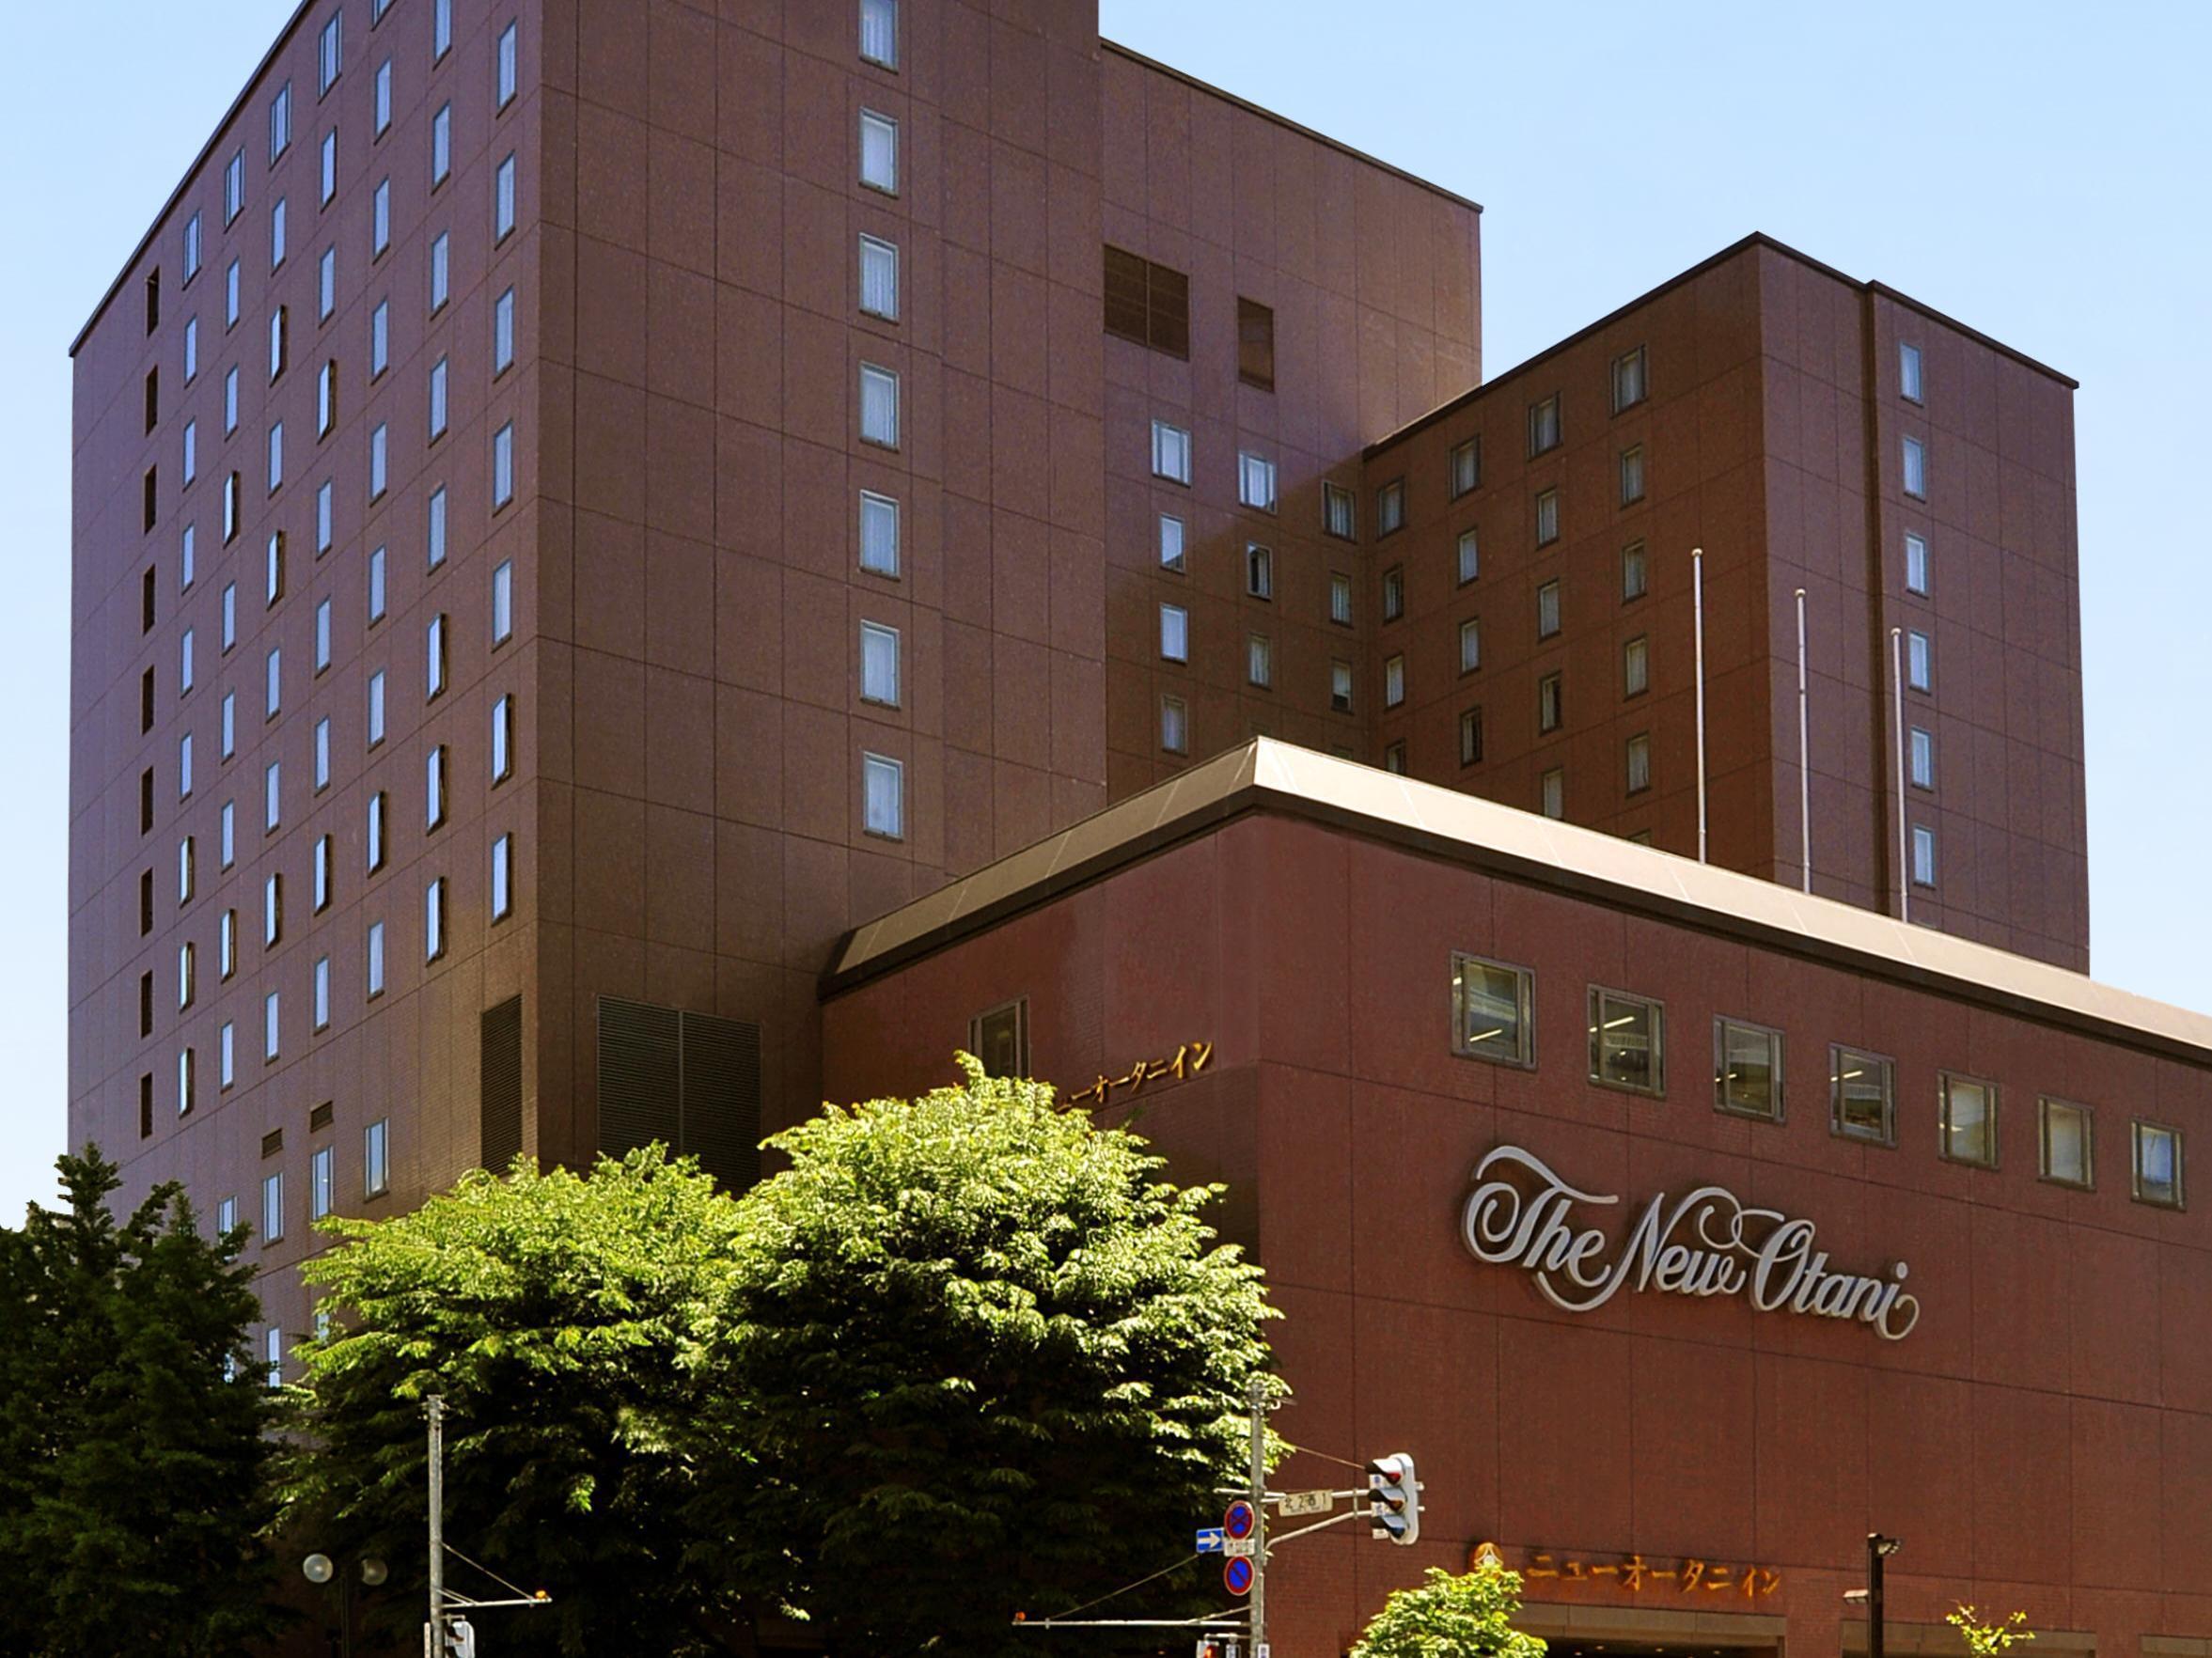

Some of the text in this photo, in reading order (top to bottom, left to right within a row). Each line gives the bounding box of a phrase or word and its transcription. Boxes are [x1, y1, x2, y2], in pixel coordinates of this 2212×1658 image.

[1464, 1145, 1921, 1341] The New Otani
[1525, 1555, 1781, 1597] ニューオータニイン
